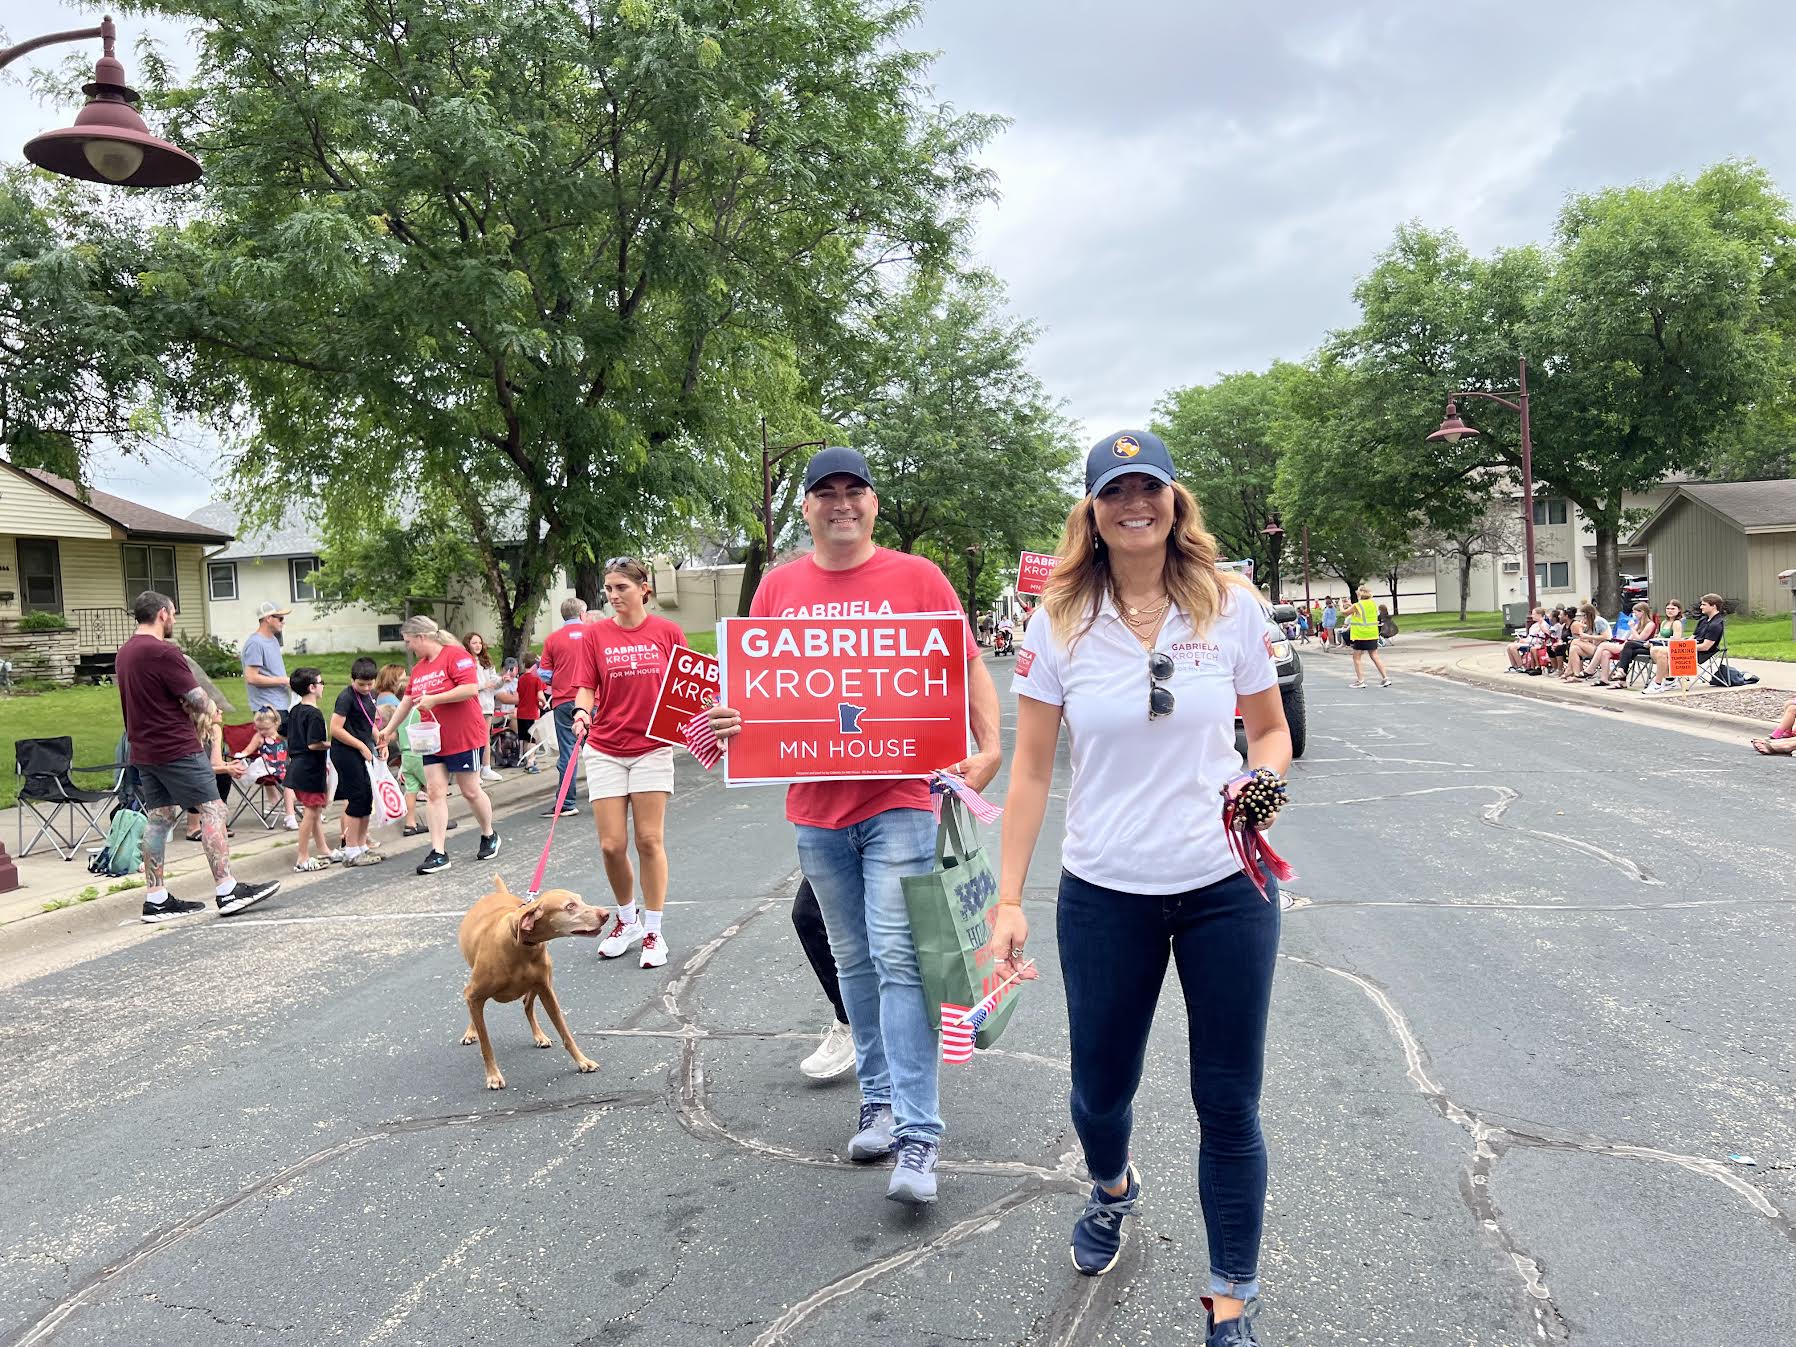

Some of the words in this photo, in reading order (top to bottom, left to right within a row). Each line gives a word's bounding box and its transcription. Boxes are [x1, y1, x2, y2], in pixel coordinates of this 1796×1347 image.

[1025, 555, 1061, 567] GABRI
[781, 600, 893, 618] GABRIELA
[741, 628, 950, 658] GABRIELA
[1171, 643, 1219, 652] GABRIELA
[604, 644, 659, 655] GABRIELA
[606, 653, 659, 664] KROETCH
[1172, 651, 1219, 661] KROETCH
[610, 671, 623, 679] FOR
[678, 655, 720, 684] GAB
[745, 669, 948, 698] KROETCH
[780, 740, 817, 759] MN
[829, 739, 916, 758] HOUSE
